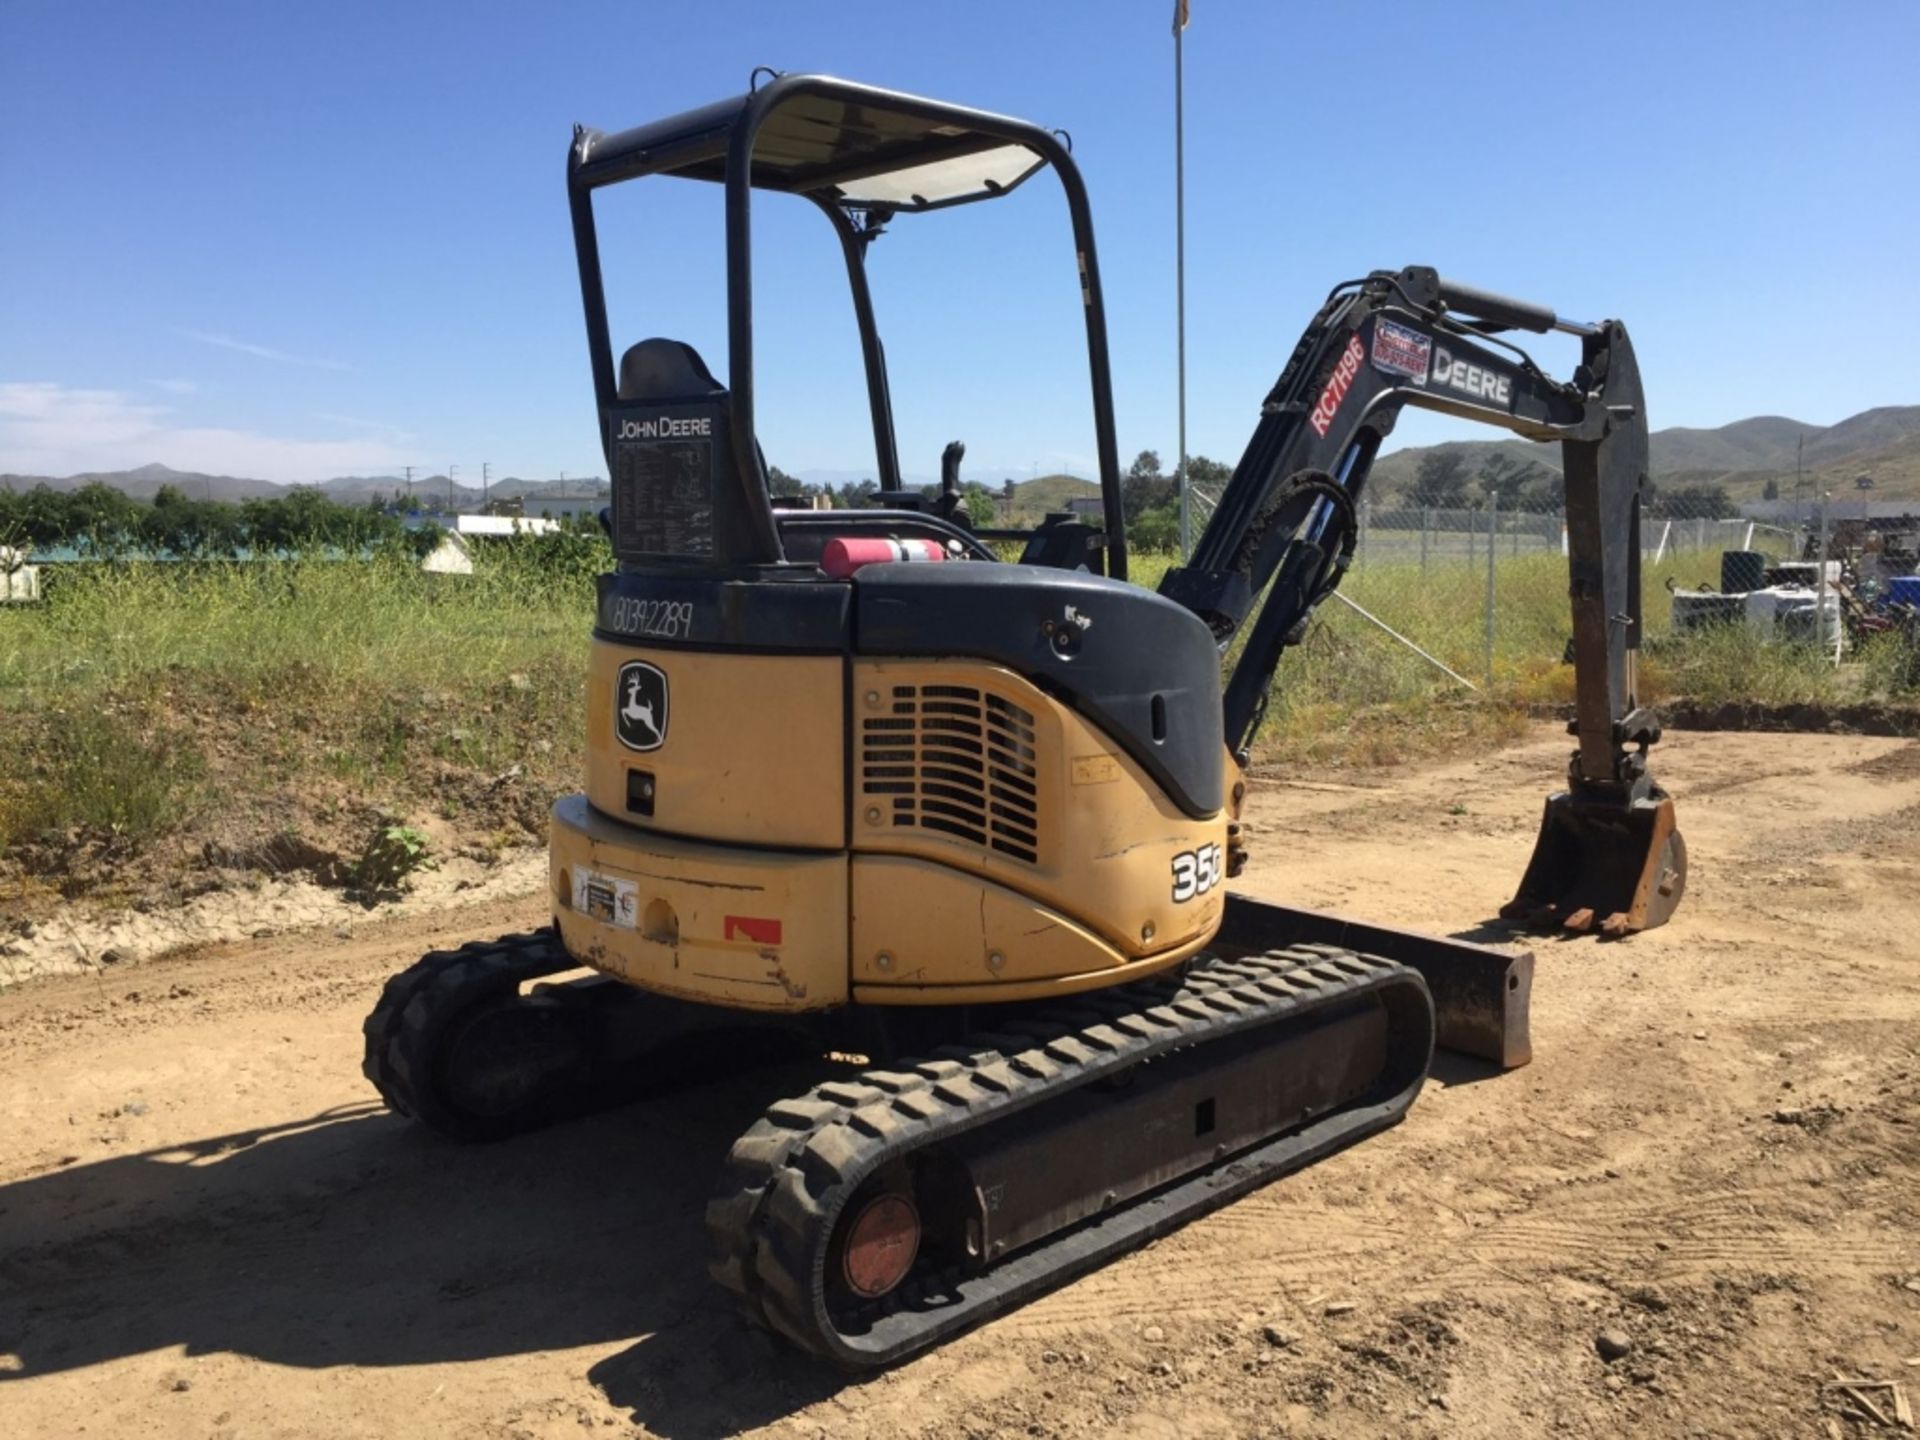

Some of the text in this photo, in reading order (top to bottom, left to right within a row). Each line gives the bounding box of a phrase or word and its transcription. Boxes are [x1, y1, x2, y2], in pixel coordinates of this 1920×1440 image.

[1310, 338, 1365, 437] RC7H96
[1432, 346, 1512, 404] DEERE
[617, 416, 712, 439] JOHN DEERE
